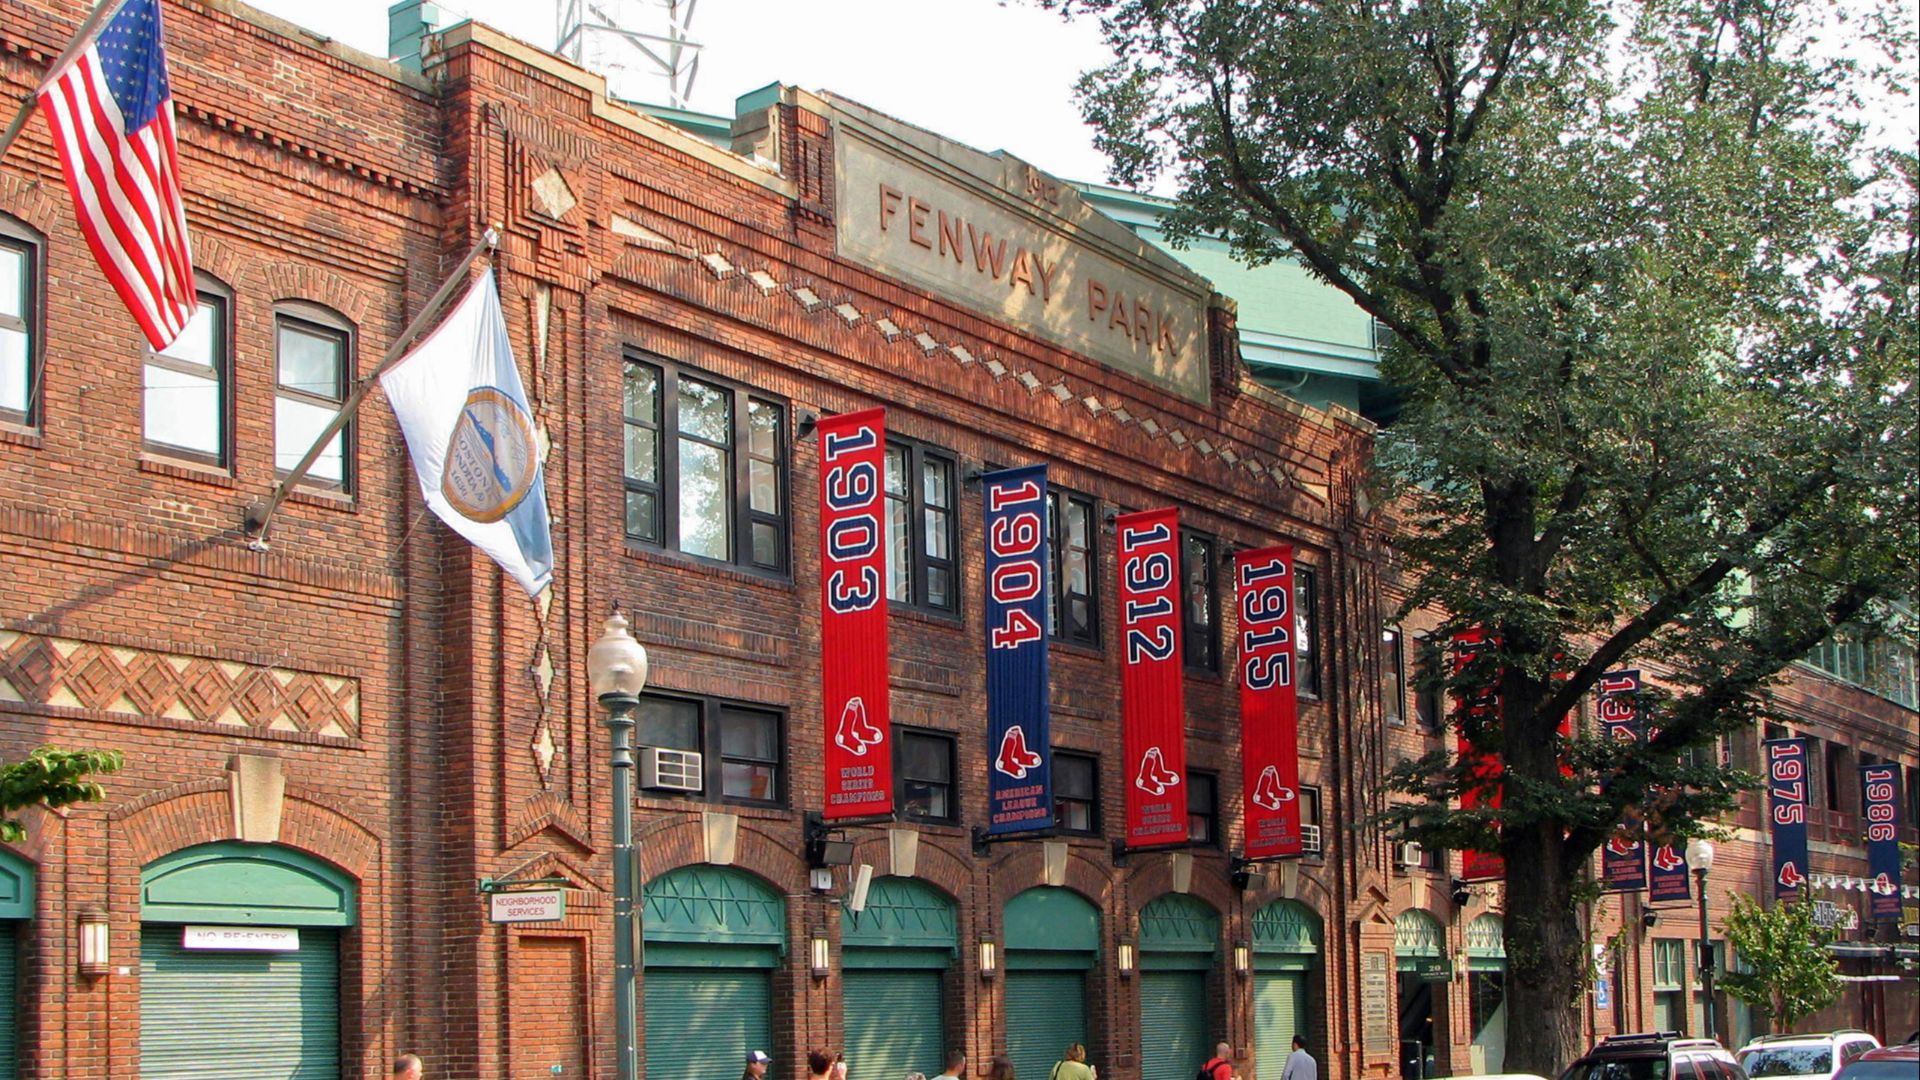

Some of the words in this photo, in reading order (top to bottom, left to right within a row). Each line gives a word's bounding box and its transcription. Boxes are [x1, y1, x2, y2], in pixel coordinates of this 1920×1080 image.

[880, 183, 1057, 303] FENWAY
[1087, 277, 1178, 358] PARK
[825, 426, 879, 614] 1903
[990, 480, 1042, 649] 1904
[1123, 522, 1175, 665] 1912
[1241, 558, 1291, 691] 1915
[840, 765, 874, 778] WORLD
[1771, 744, 1804, 825] 1975
[1866, 769, 1895, 842] 1986
[197, 931, 217, 942] NO
[223, 931, 288, 942] RE-ENTRY
[495, 896, 558, 907] NEIGHBORHOOD
[507, 907, 546, 917] SERVICES
